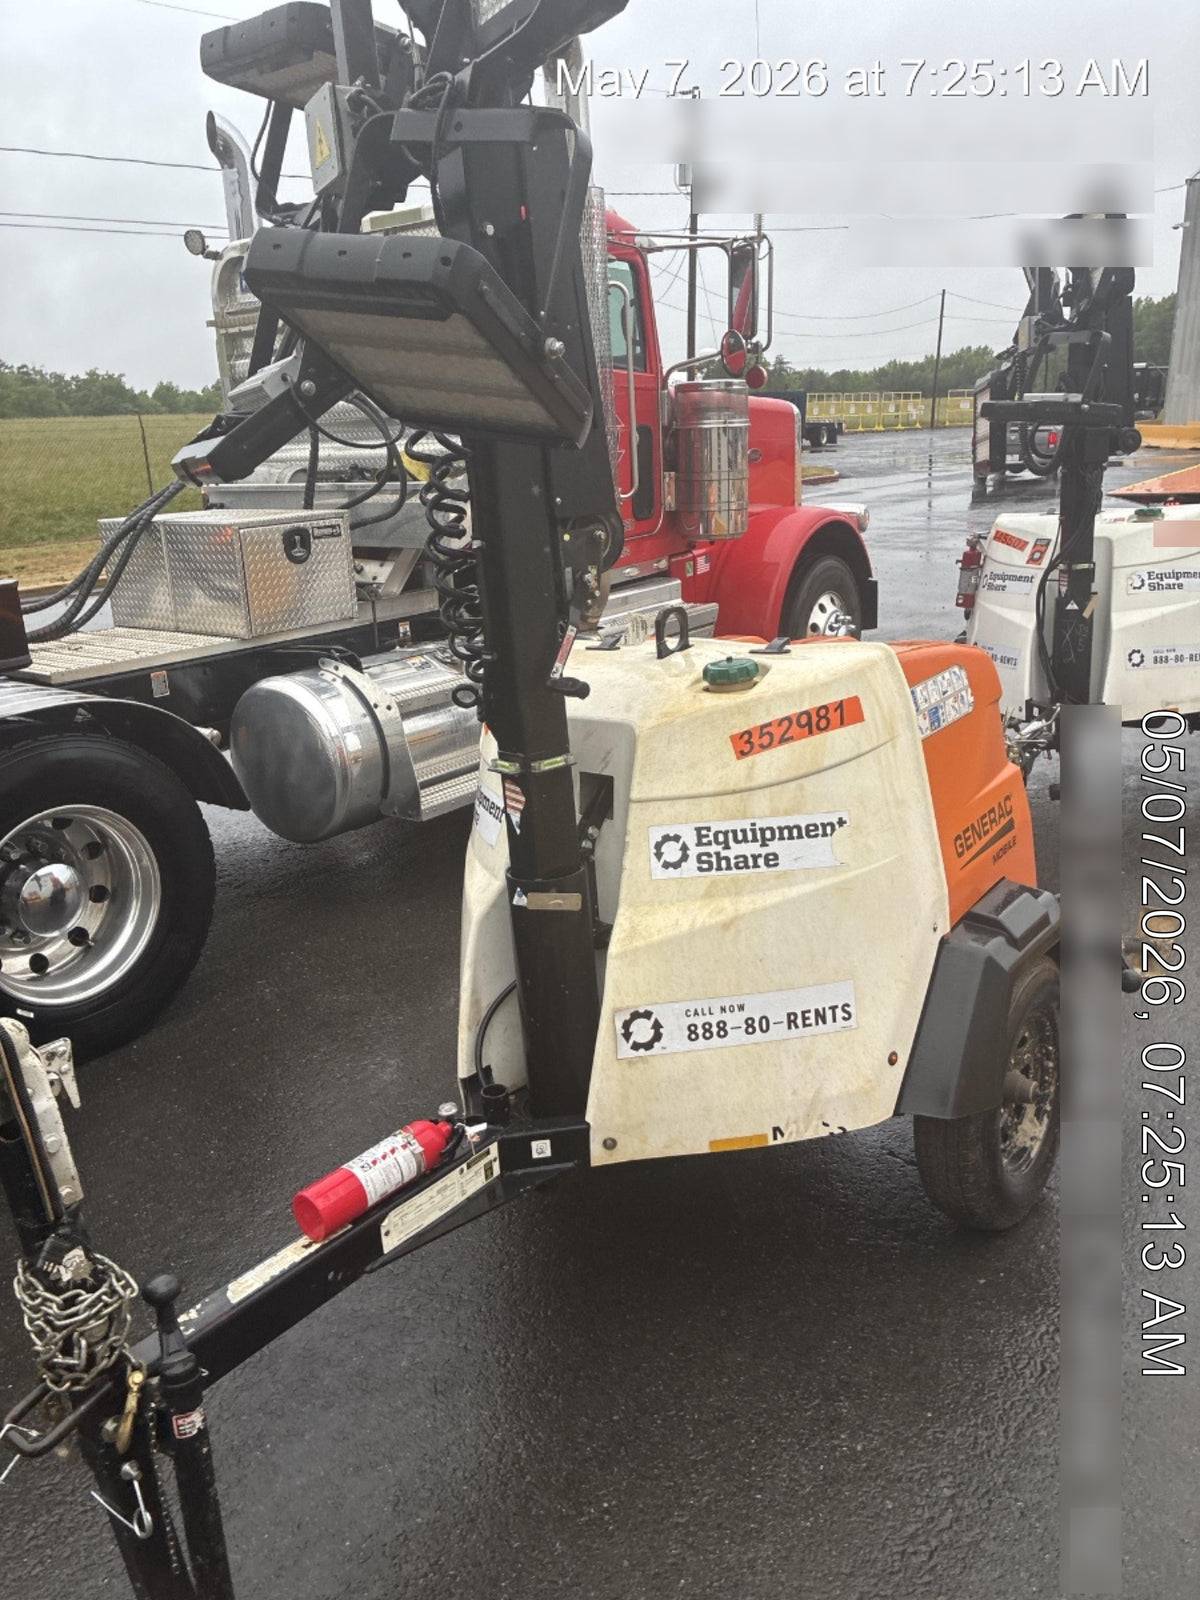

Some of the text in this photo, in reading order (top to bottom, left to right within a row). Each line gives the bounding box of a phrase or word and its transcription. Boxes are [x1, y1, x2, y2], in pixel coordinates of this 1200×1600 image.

[1147, 569, 1200, 582] Equipme
[1148, 582, 1184, 591] Share
[738, 700, 848, 757] 352981
[695, 816, 848, 851] Equipment
[953, 792, 1014, 859] GENERAC
[696, 851, 780, 873] Share
[992, 835, 1018, 866] MOBILE
[685, 1003, 747, 1018] CALL NOW
[687, 1003, 853, 1042] 888-80-RENTS
